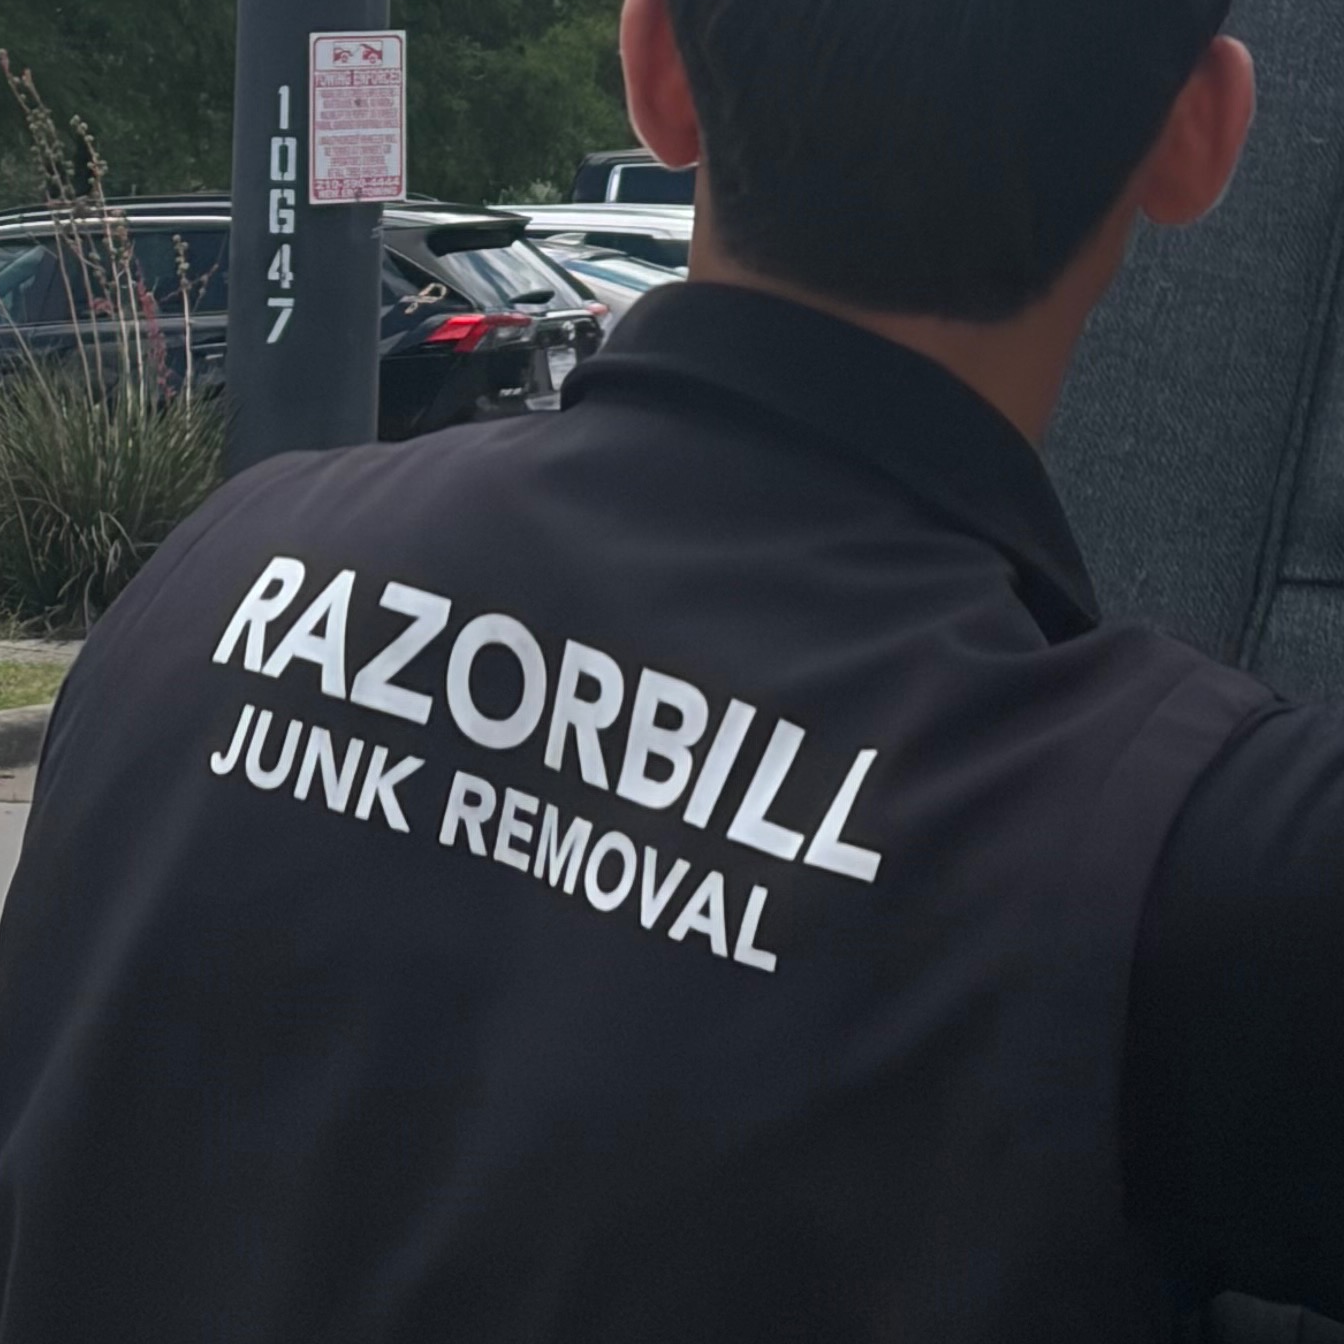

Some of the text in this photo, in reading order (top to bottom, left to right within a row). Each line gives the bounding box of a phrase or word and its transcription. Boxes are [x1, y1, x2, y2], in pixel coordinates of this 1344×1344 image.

[266, 85, 297, 344] 10647
[210, 703, 777, 972] JUNK REMOVAL
[212, 556, 882, 883] RAZORBILL
